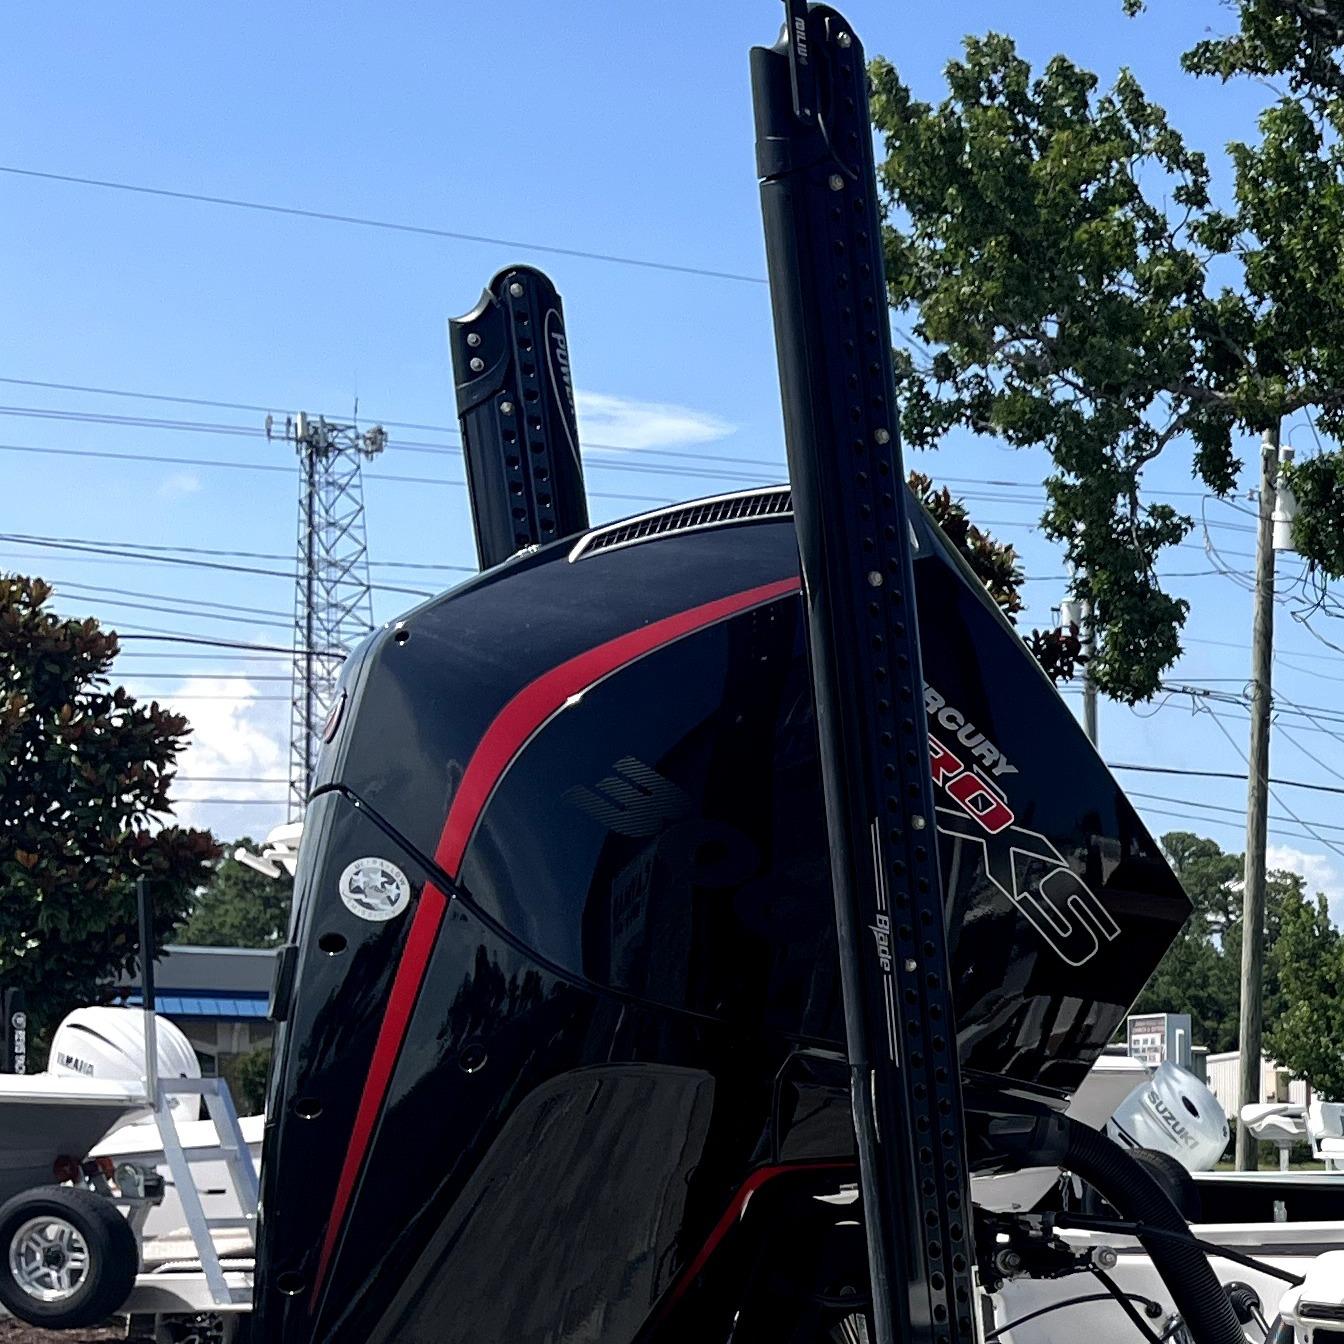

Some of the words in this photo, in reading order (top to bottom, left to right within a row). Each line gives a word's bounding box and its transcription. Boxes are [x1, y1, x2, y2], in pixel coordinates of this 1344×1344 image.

[923, 681, 1019, 776] RCURY
[868, 913, 892, 971] Blade
[1147, 1090, 1200, 1150] SUZUKI
